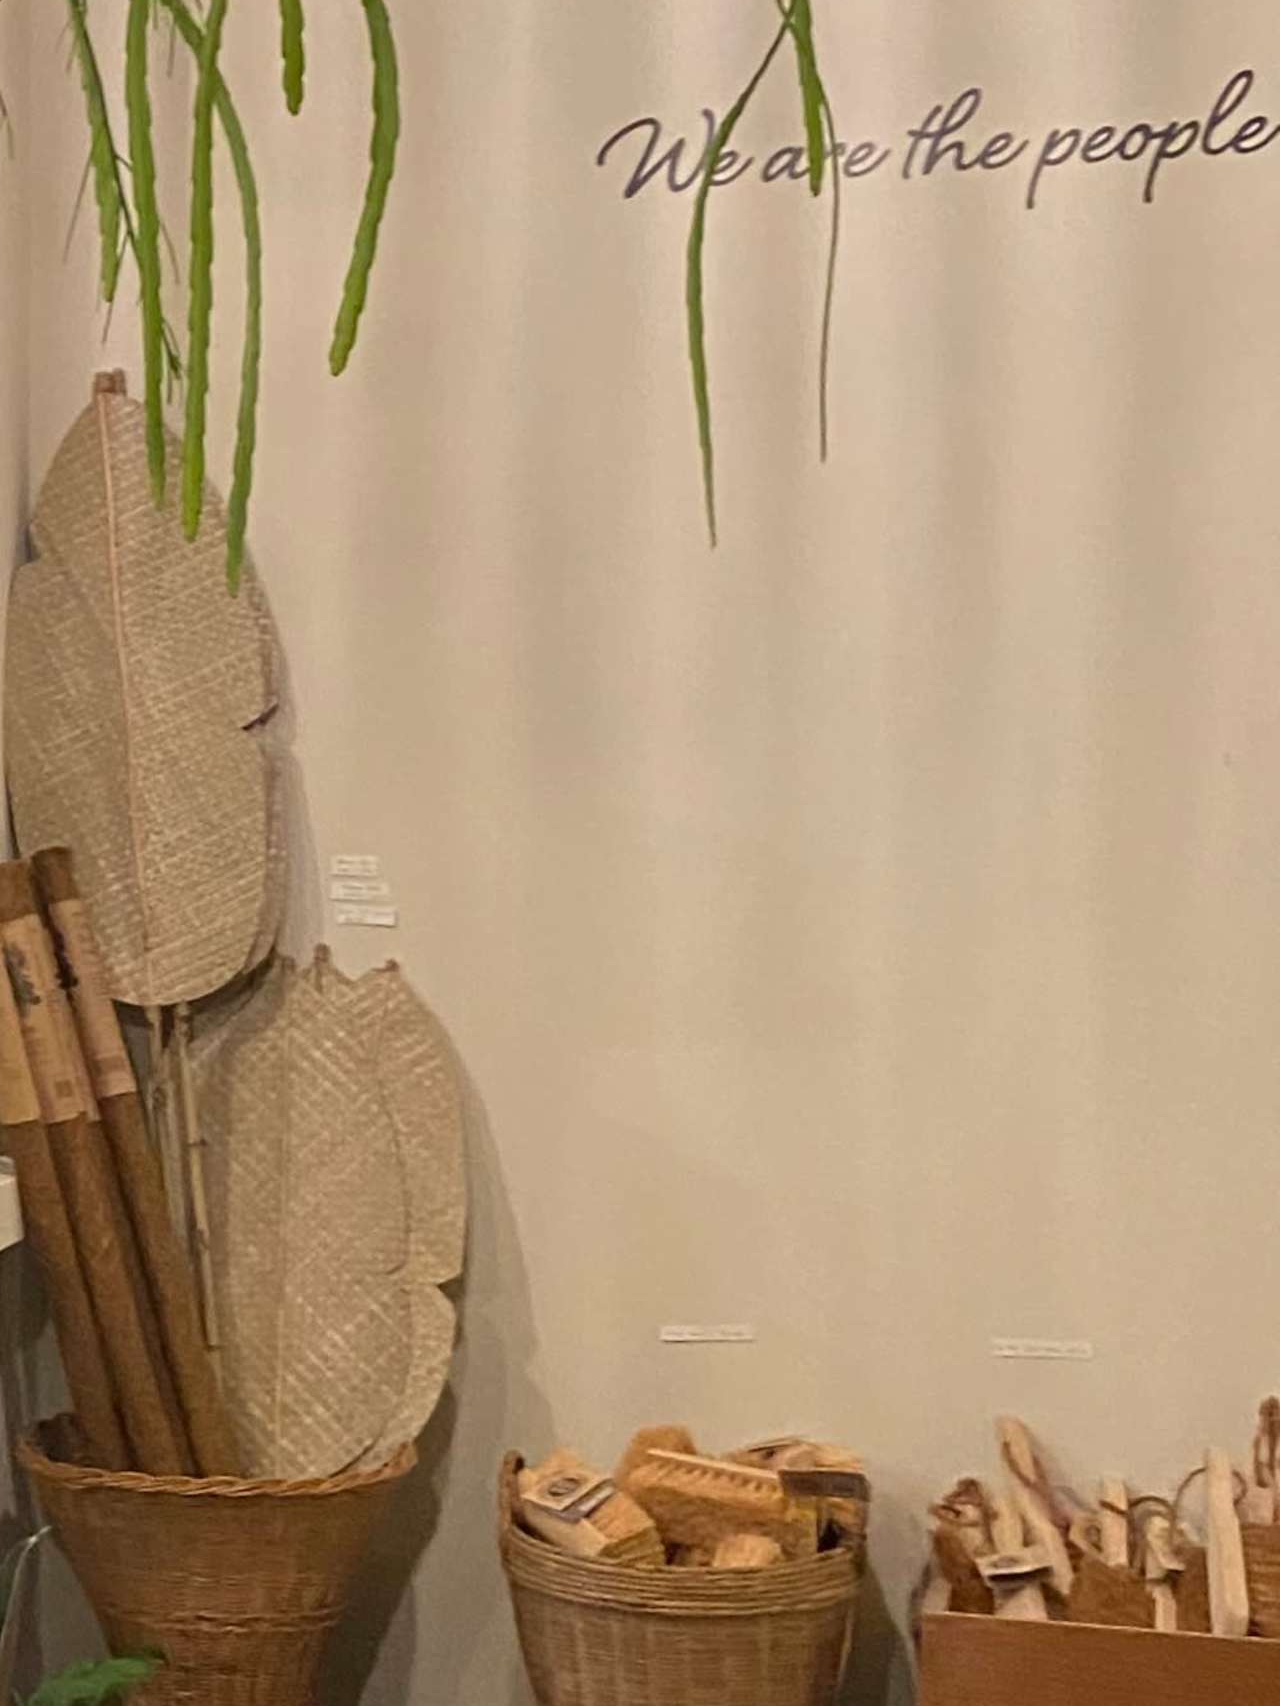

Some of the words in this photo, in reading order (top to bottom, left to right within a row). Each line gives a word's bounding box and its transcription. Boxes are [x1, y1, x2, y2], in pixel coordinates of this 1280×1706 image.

[596, 108, 755, 199] We
[901, 88, 1029, 180] the
[1026, 69, 1280, 210] people
